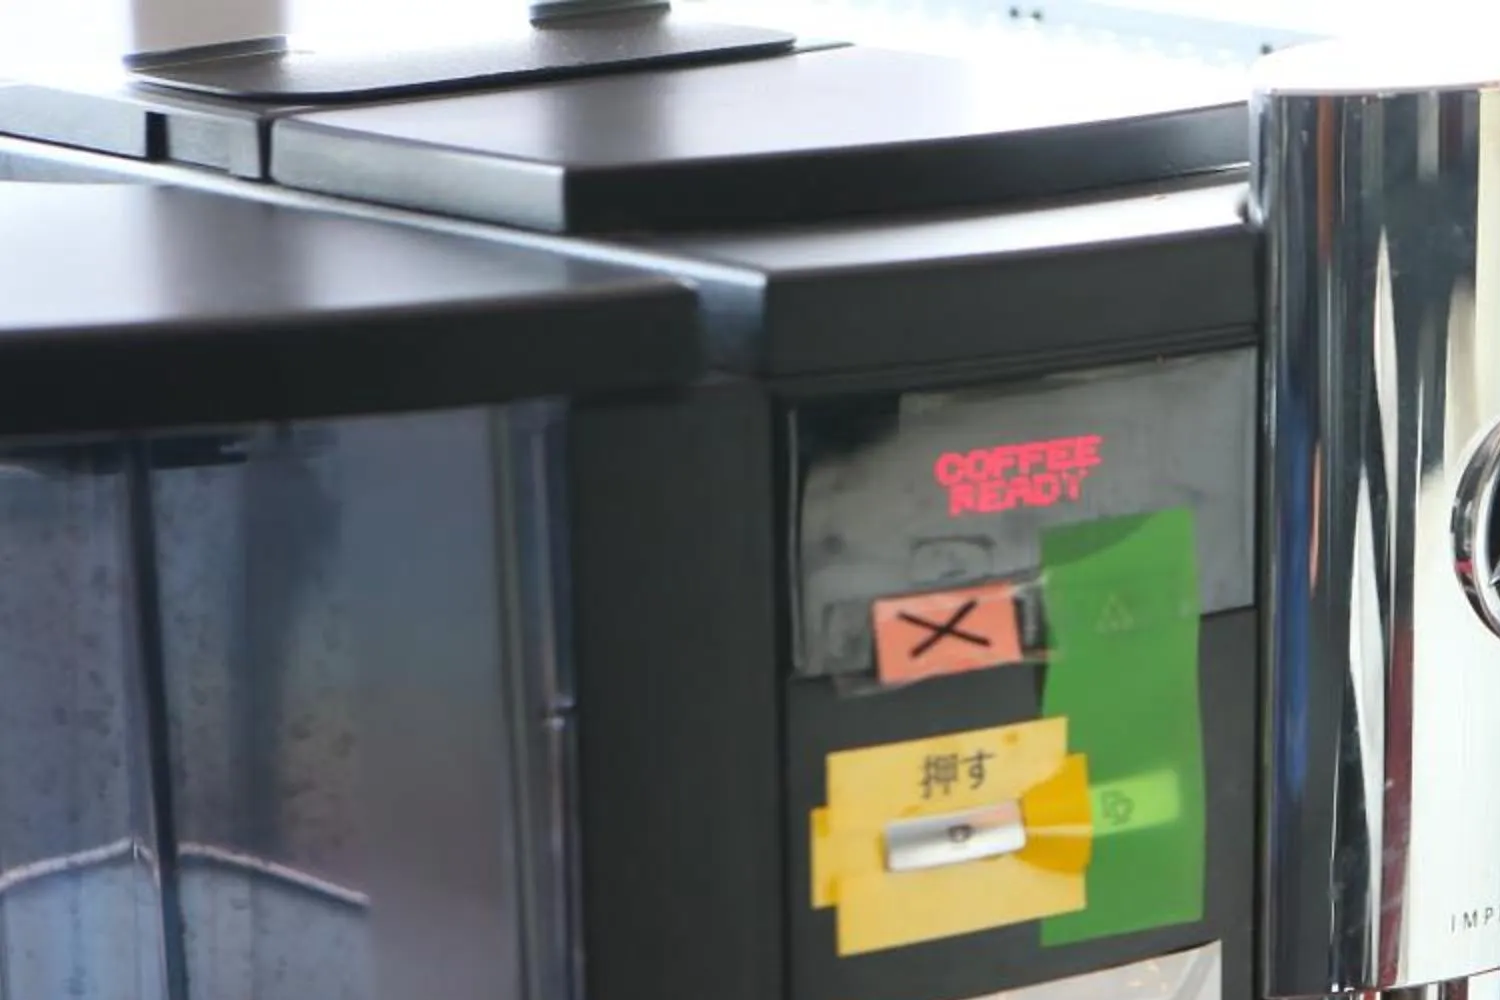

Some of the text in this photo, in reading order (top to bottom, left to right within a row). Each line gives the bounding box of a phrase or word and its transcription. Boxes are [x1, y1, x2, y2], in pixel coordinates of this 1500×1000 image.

[933, 434, 1103, 487] COFFEE
[949, 466, 1089, 518] READY
[918, 748, 997, 800] 押す
